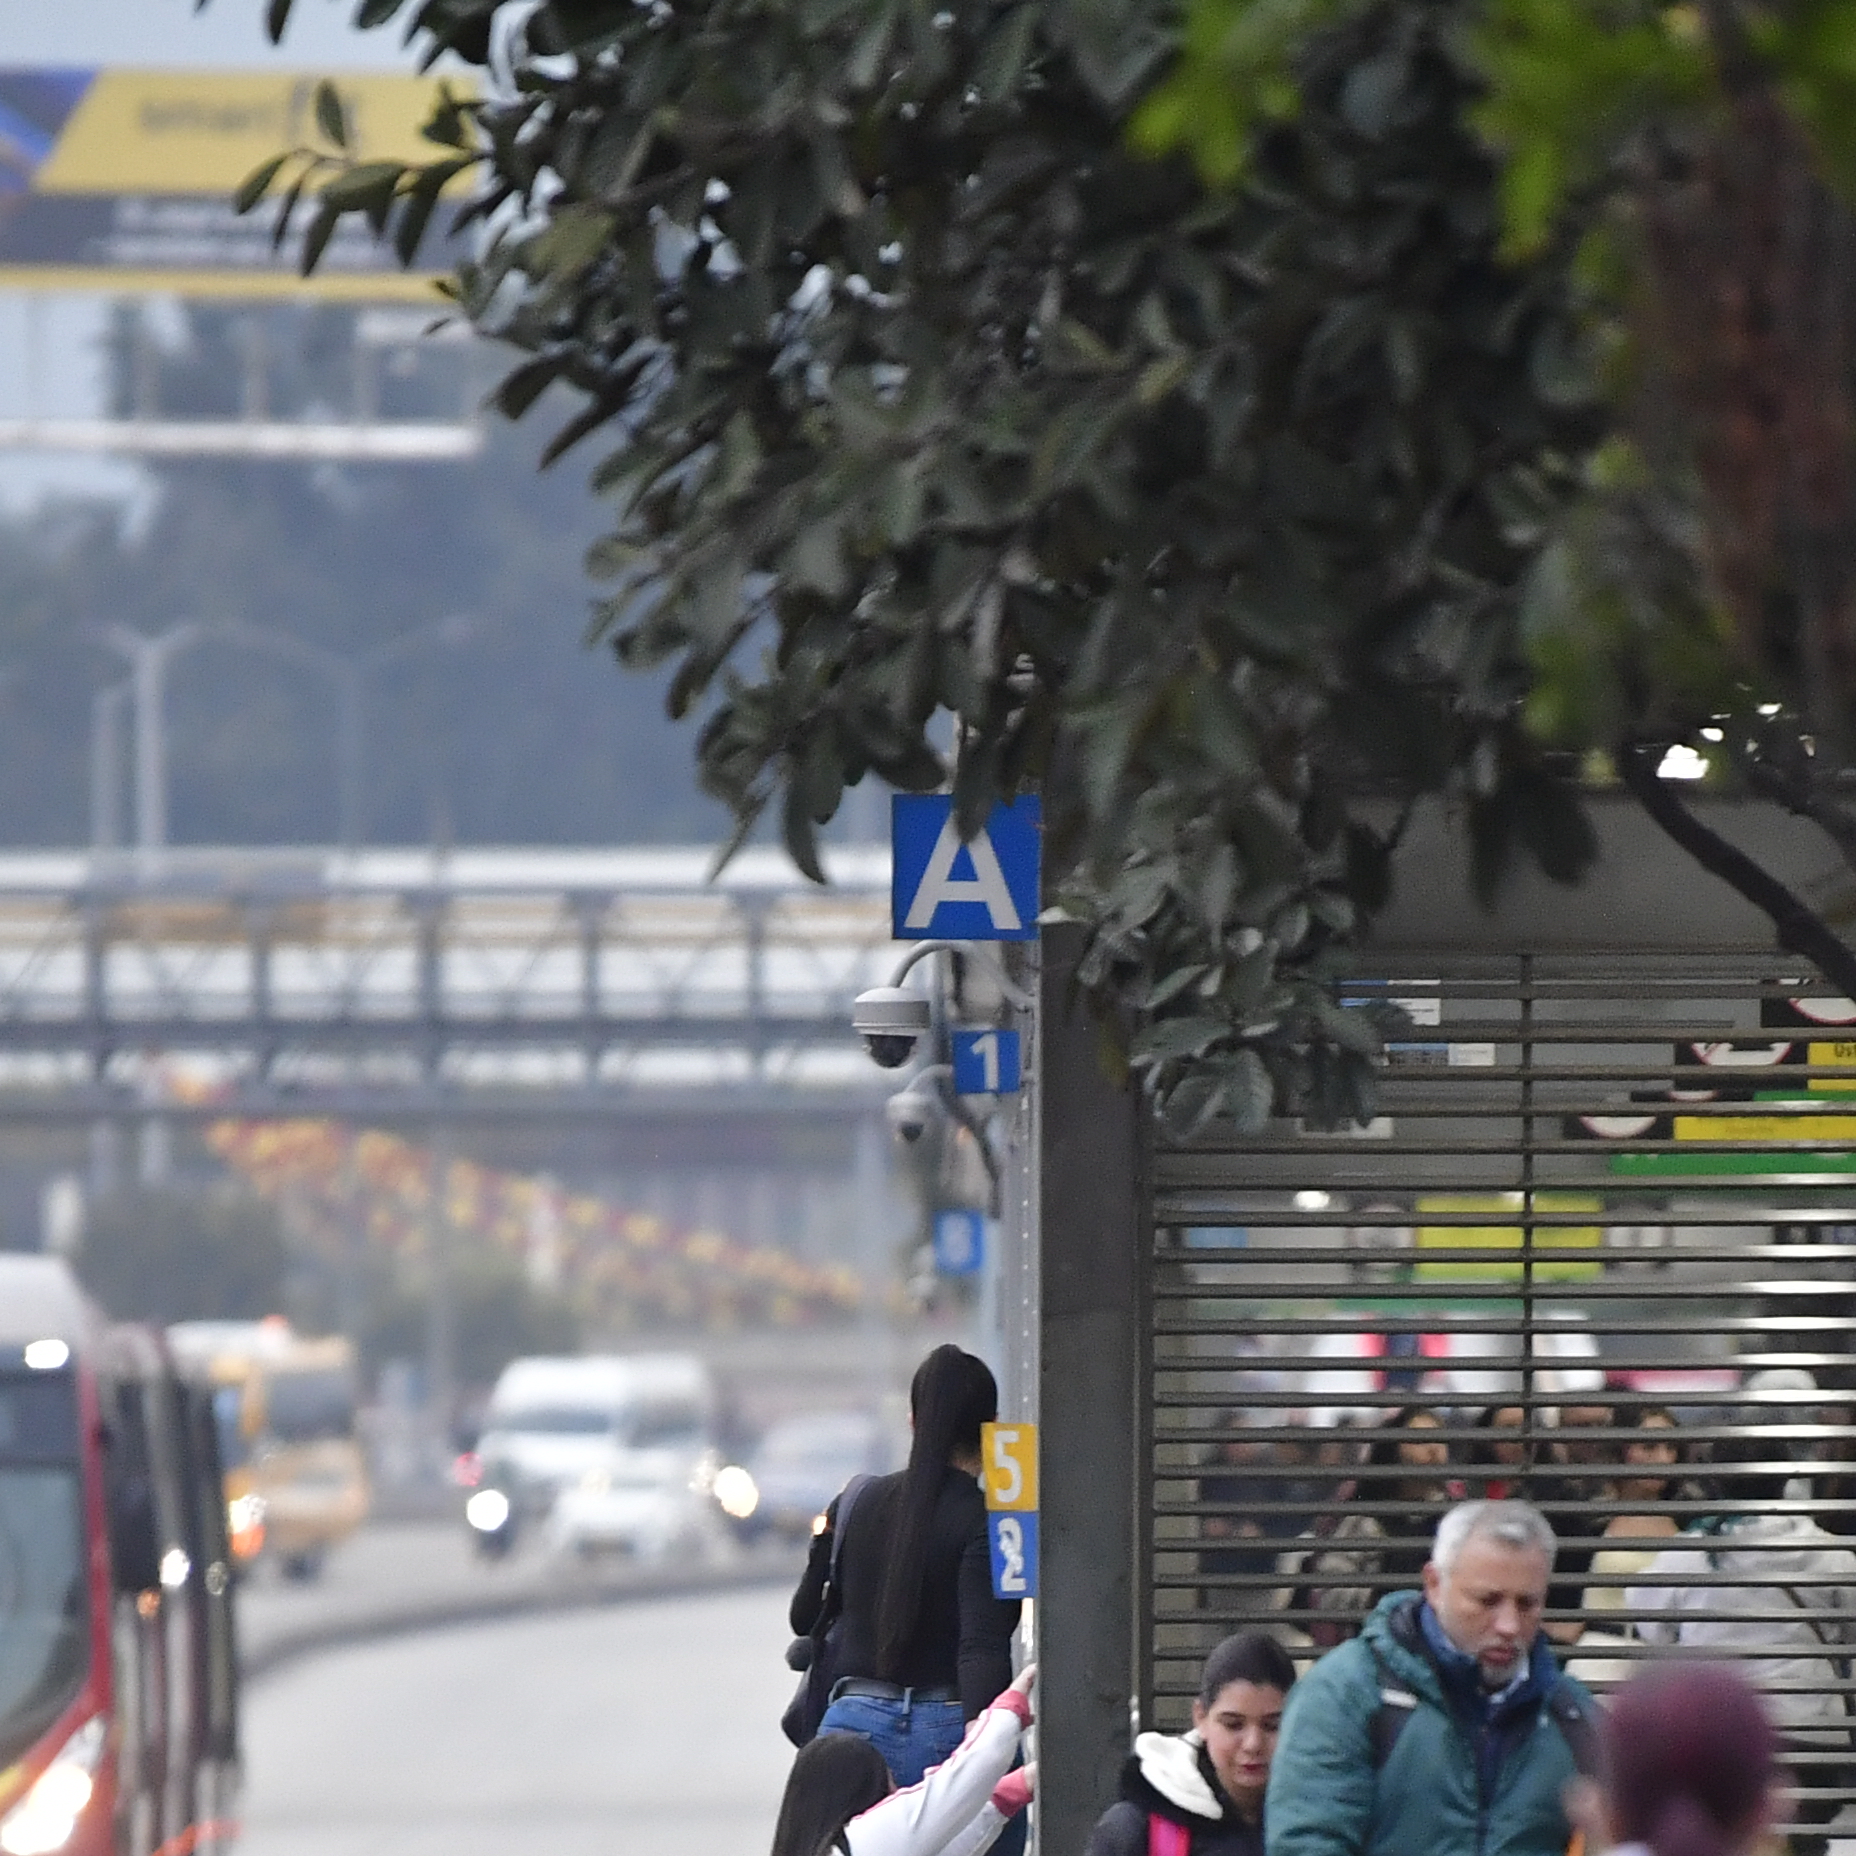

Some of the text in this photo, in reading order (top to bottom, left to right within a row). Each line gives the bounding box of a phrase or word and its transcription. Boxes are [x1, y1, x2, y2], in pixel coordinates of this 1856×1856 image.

[903, 806, 1023, 931] A
[970, 1033, 999, 1092] 1
[995, 1430, 1023, 1503] 5
